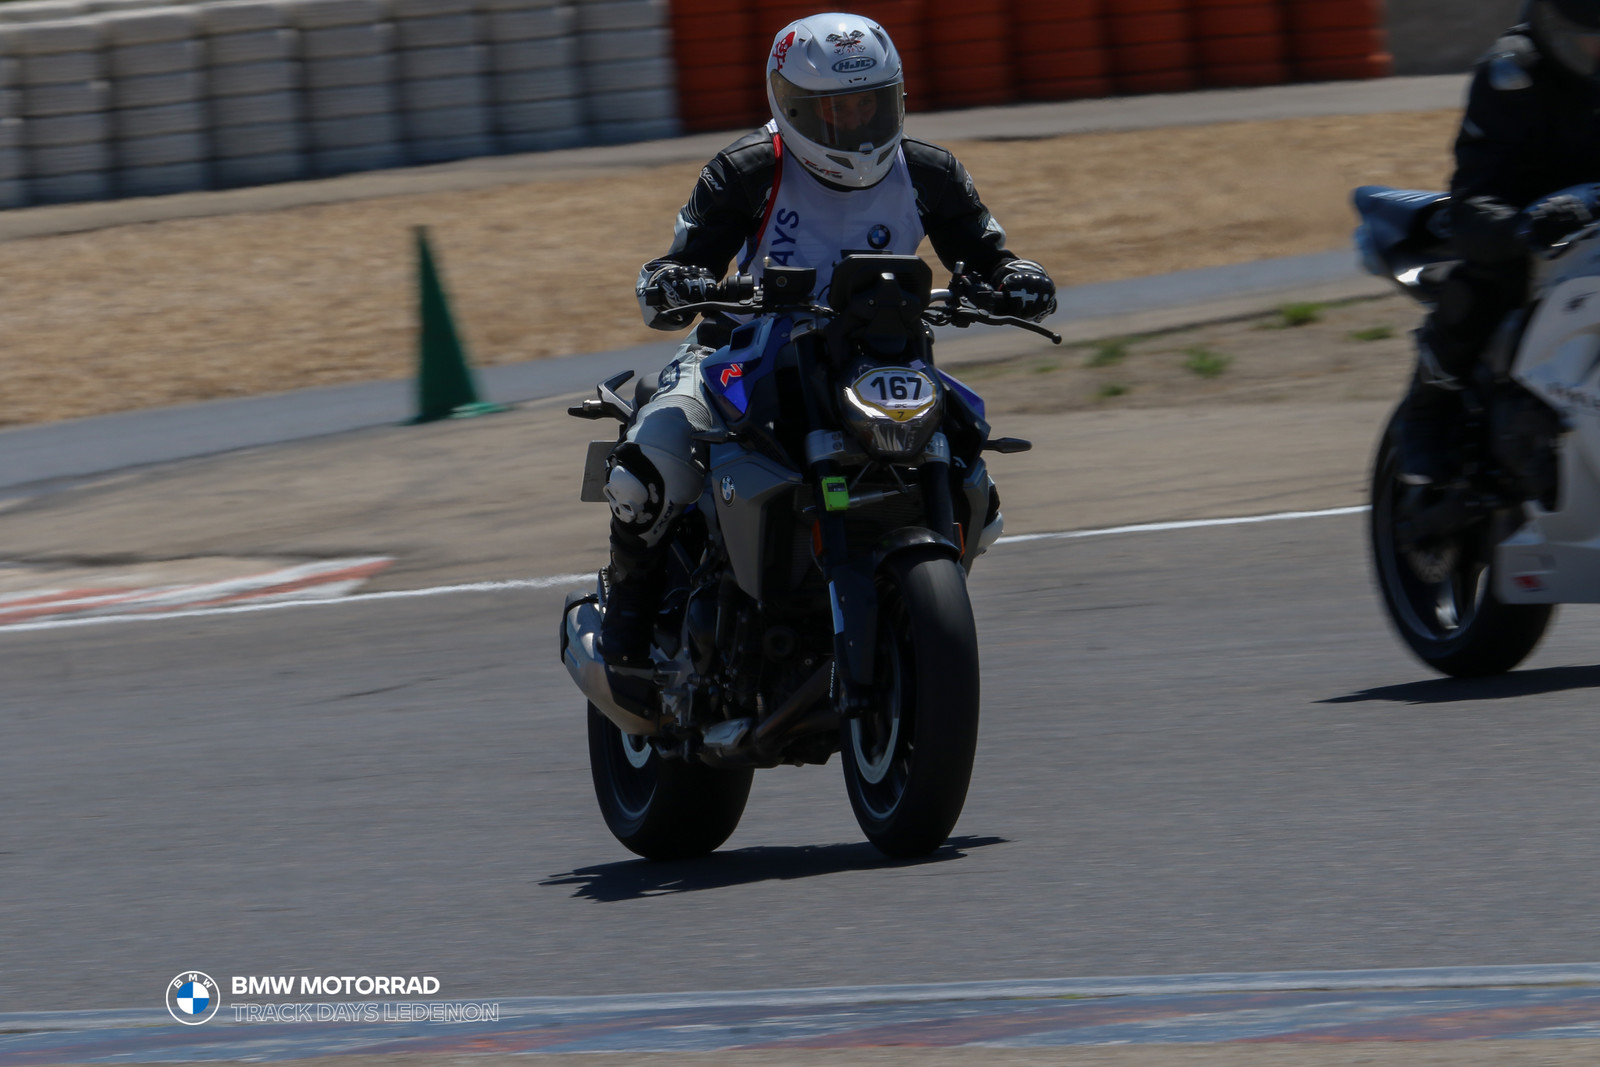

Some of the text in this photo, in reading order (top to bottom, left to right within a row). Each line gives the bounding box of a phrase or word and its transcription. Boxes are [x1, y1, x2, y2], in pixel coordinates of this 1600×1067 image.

[838, 59, 871, 71] HJC
[870, 376, 922, 401] 167
[897, 411, 905, 419] 7
